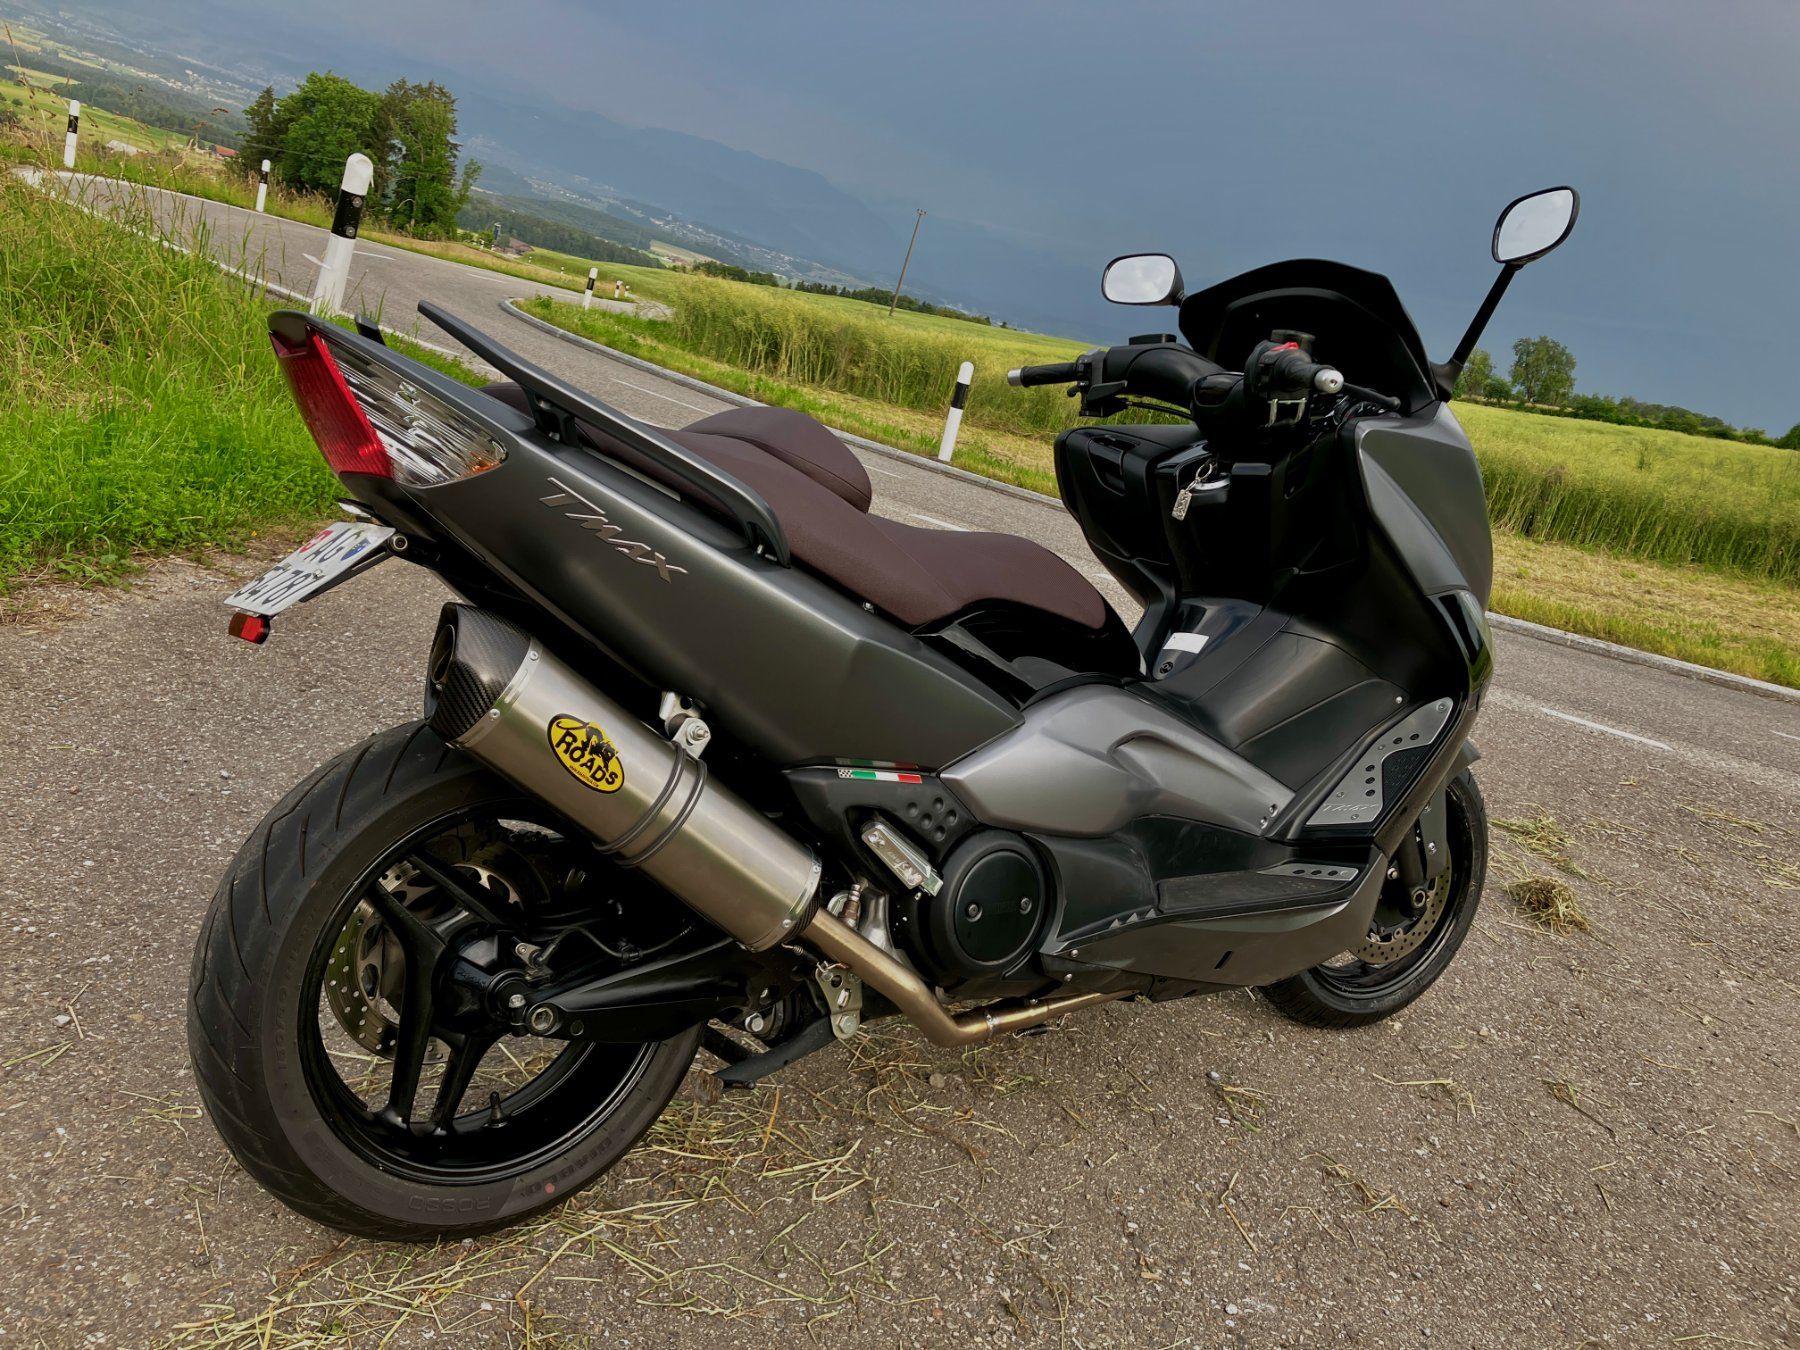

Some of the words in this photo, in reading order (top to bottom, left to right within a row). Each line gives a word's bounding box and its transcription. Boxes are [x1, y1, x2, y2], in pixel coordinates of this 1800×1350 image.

[303, 528, 364, 563] AG
[538, 477, 689, 584] TMAX
[233, 565, 326, 607] 54787
[554, 730, 619, 785] ROADS
[408, 1195, 490, 1212] ROSSO
